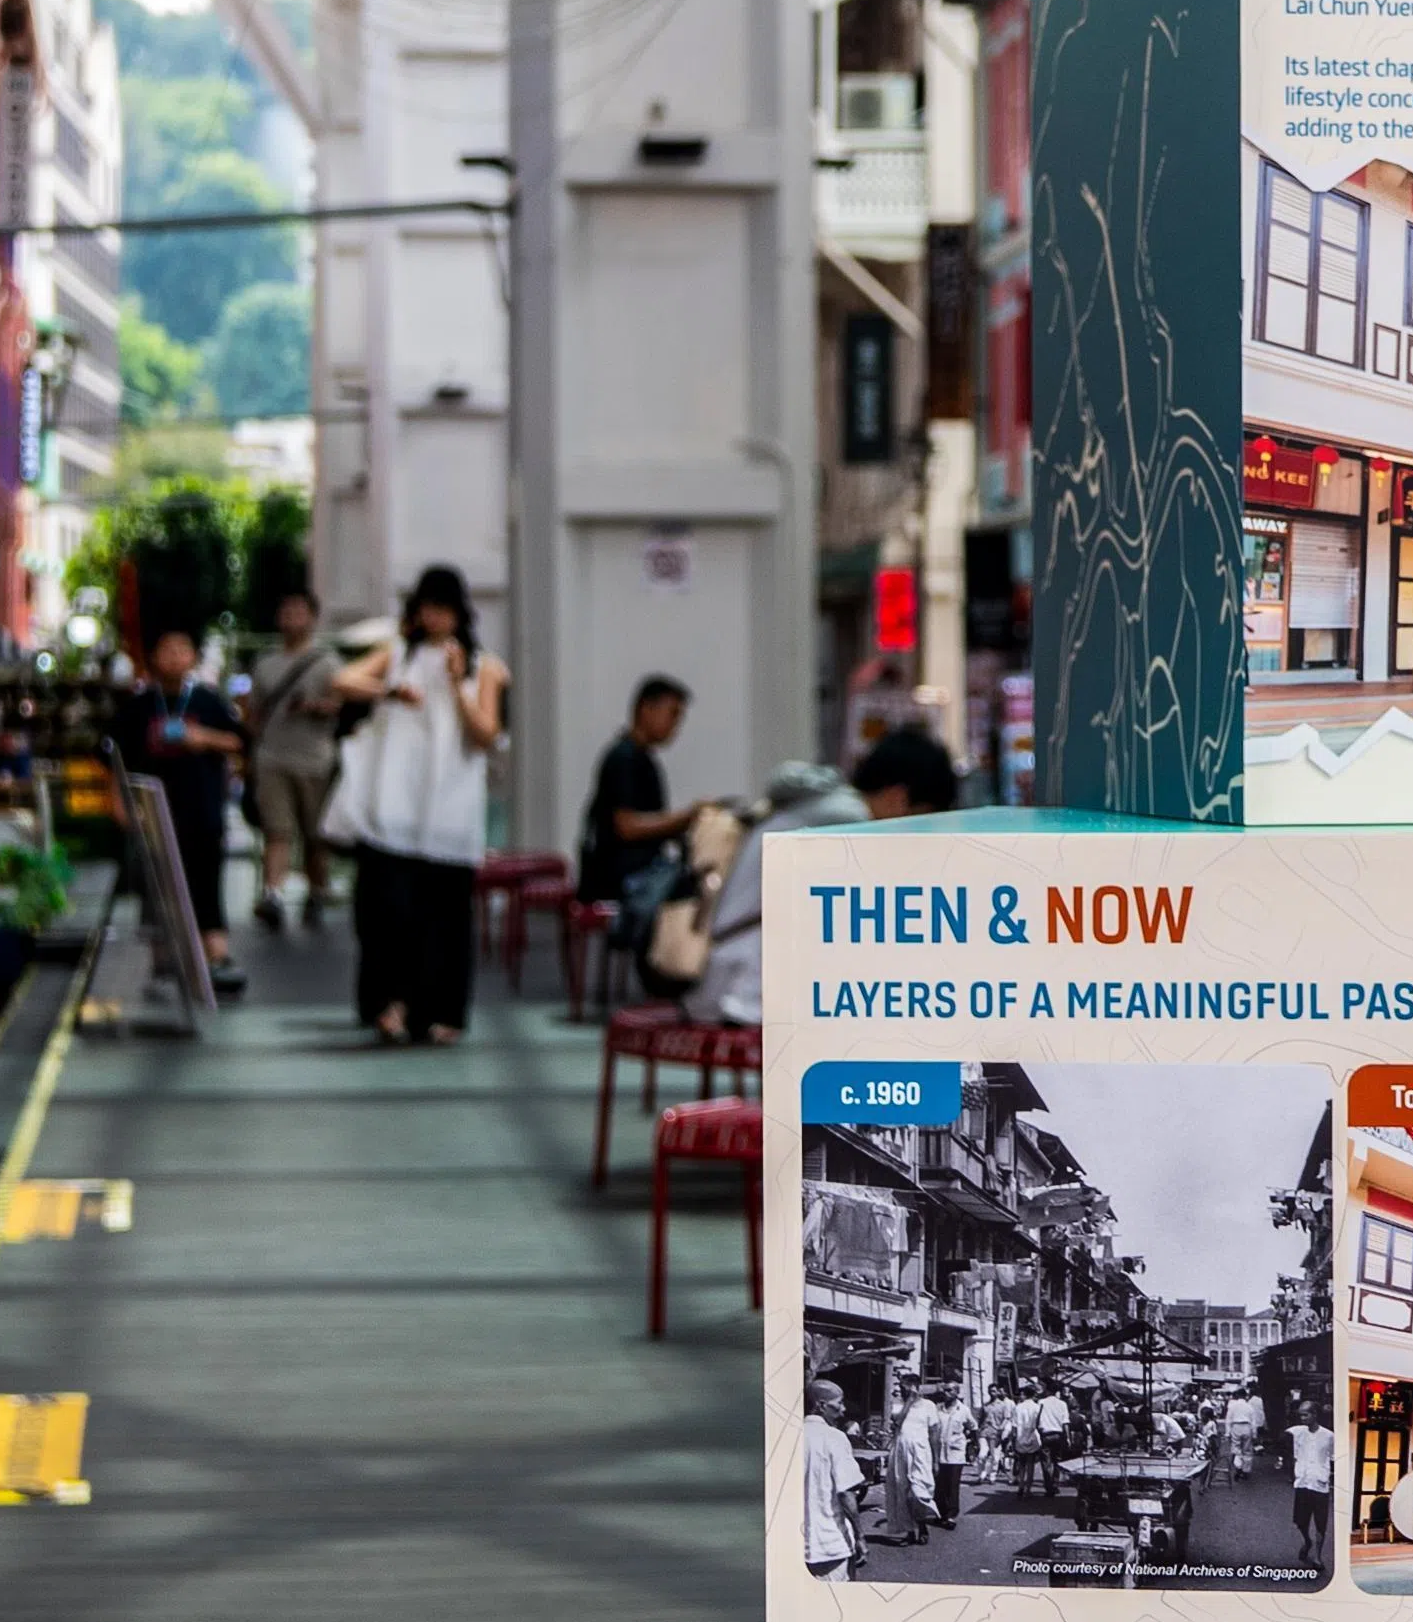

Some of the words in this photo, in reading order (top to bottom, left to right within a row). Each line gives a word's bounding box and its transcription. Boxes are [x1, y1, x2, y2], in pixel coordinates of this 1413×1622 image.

[1284, 117, 1353, 144] adding
[1357, 120, 1379, 138] to
[1274, 469, 1310, 487] KEE
[809, 886, 968, 944] THEN
[988, 884, 1030, 945] &
[1047, 885, 1194, 945] NOW
[813, 981, 957, 1019] LAYERS
[969, 981, 1018, 1019] OF
[1029, 982, 1055, 1018] A
[1067, 981, 1330, 1020] MEANINGFUL
[840, 1085, 861, 1105] c.
[866, 1081, 921, 1106] 1960
[1012, 1560, 1051, 1574] Photo
[1052, 1561, 1107, 1578] courtesy
[1108, 1561, 1124, 1576] of
[1125, 1561, 1178, 1577] National
[1179, 1564, 1235, 1579] Archives
[1236, 1564, 1251, 1579] of
[1251, 1565, 1319, 1583] Singapore
